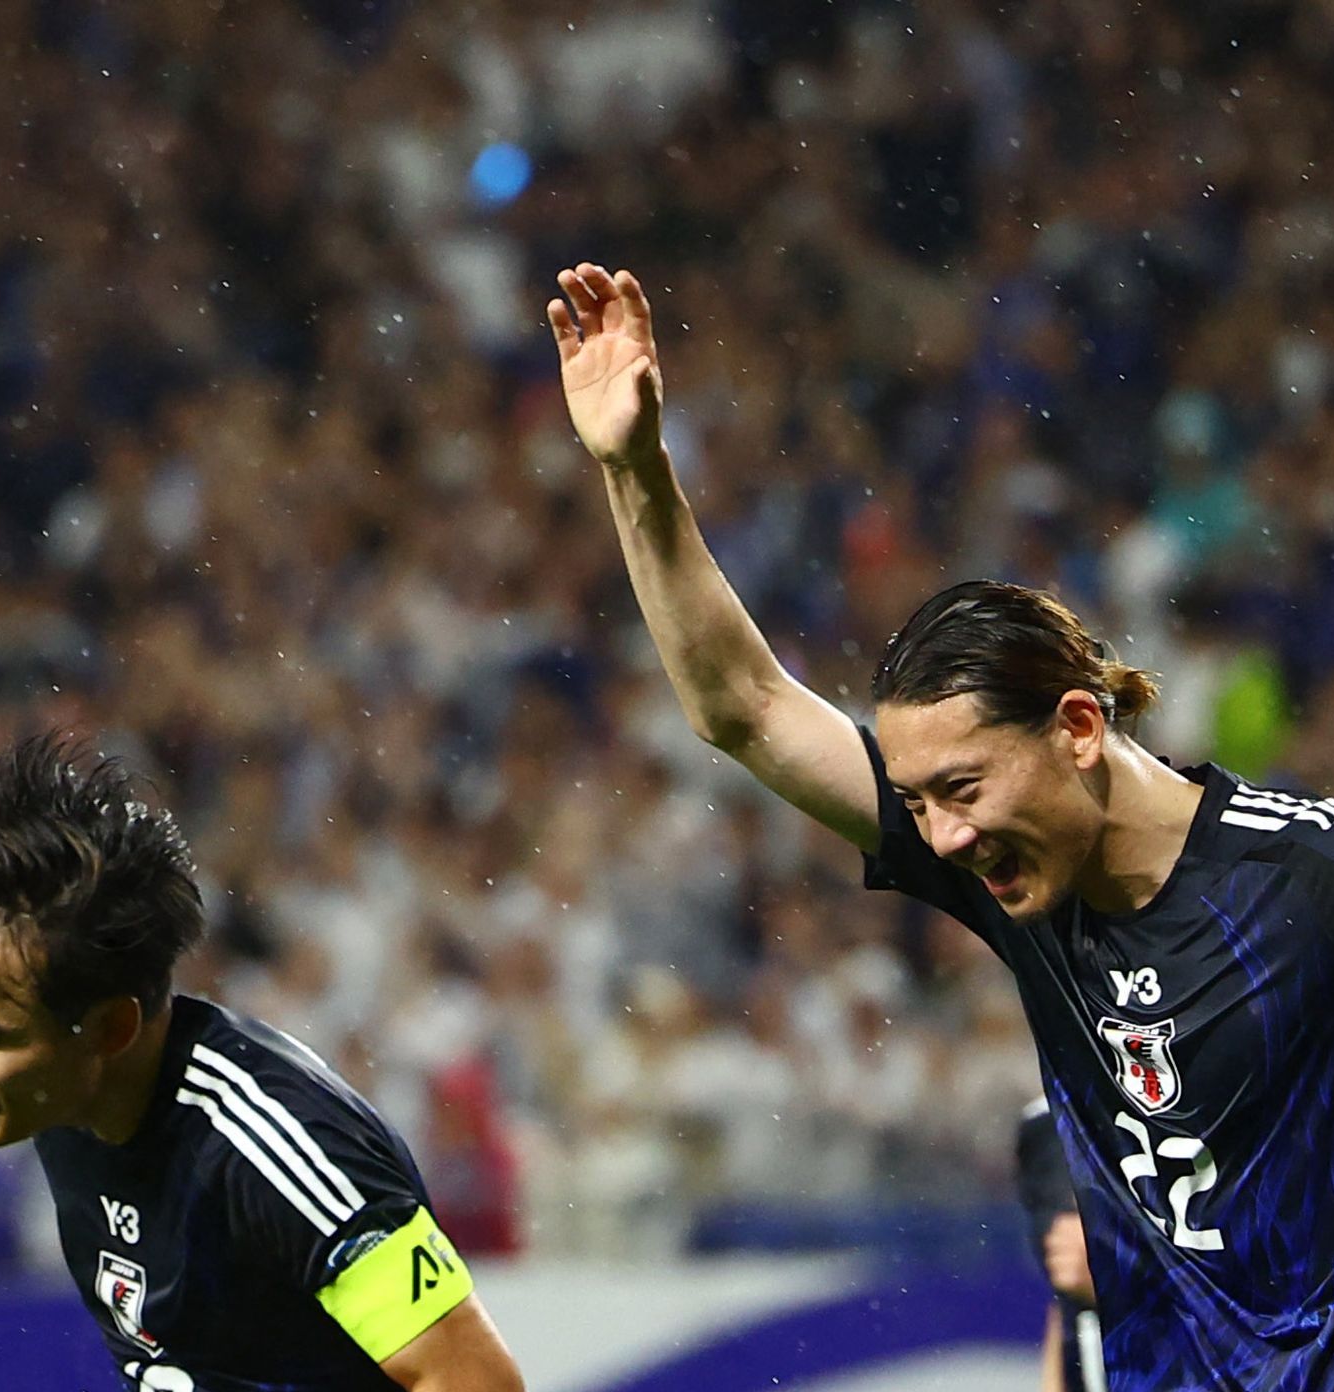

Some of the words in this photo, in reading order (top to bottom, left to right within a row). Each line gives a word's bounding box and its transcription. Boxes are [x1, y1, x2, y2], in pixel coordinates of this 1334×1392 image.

[1109, 967, 1162, 1007] Y-3
[1114, 1111, 1225, 1251] 22
[99, 1195, 141, 1245] Y-3
